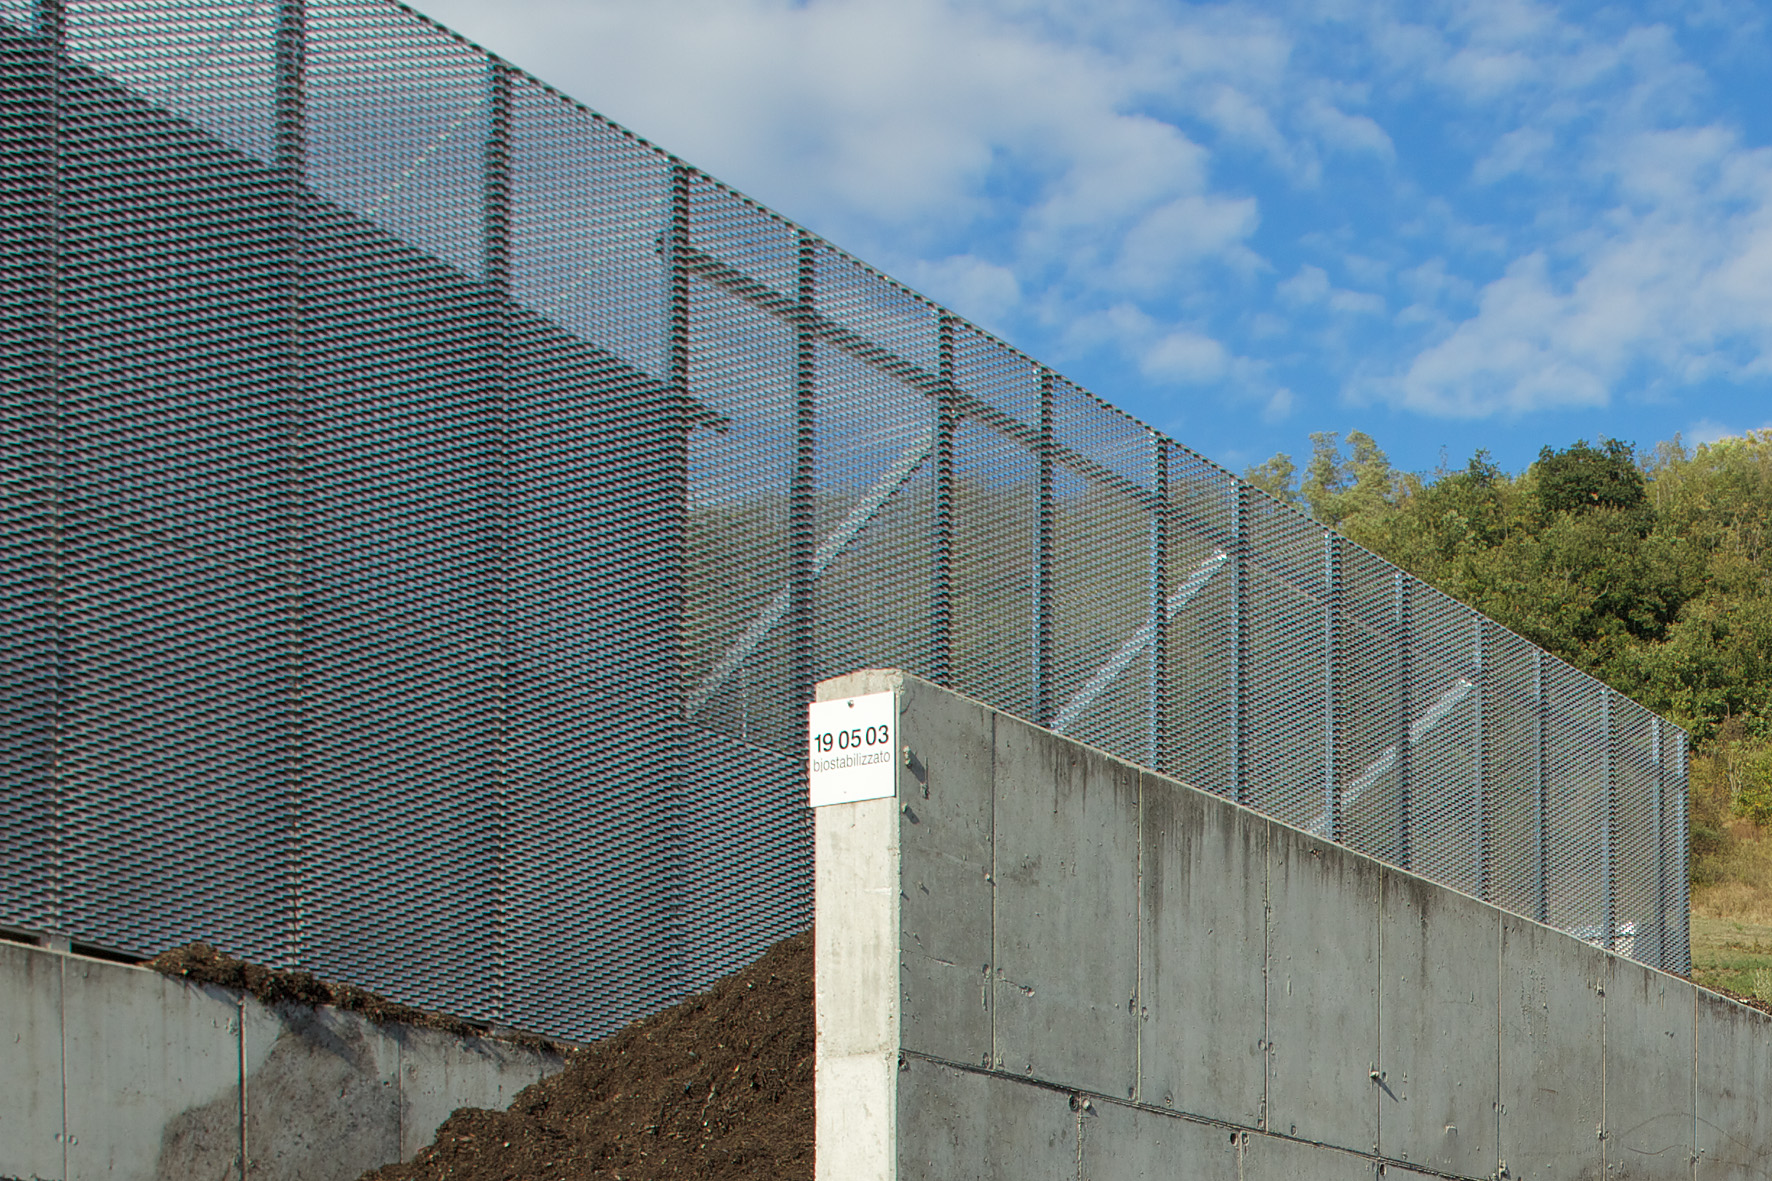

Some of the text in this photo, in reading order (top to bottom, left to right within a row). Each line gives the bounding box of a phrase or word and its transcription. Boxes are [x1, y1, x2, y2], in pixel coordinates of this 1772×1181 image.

[814, 724, 889, 753] 19 05 03
[813, 751, 891, 772] biostabilizzato
